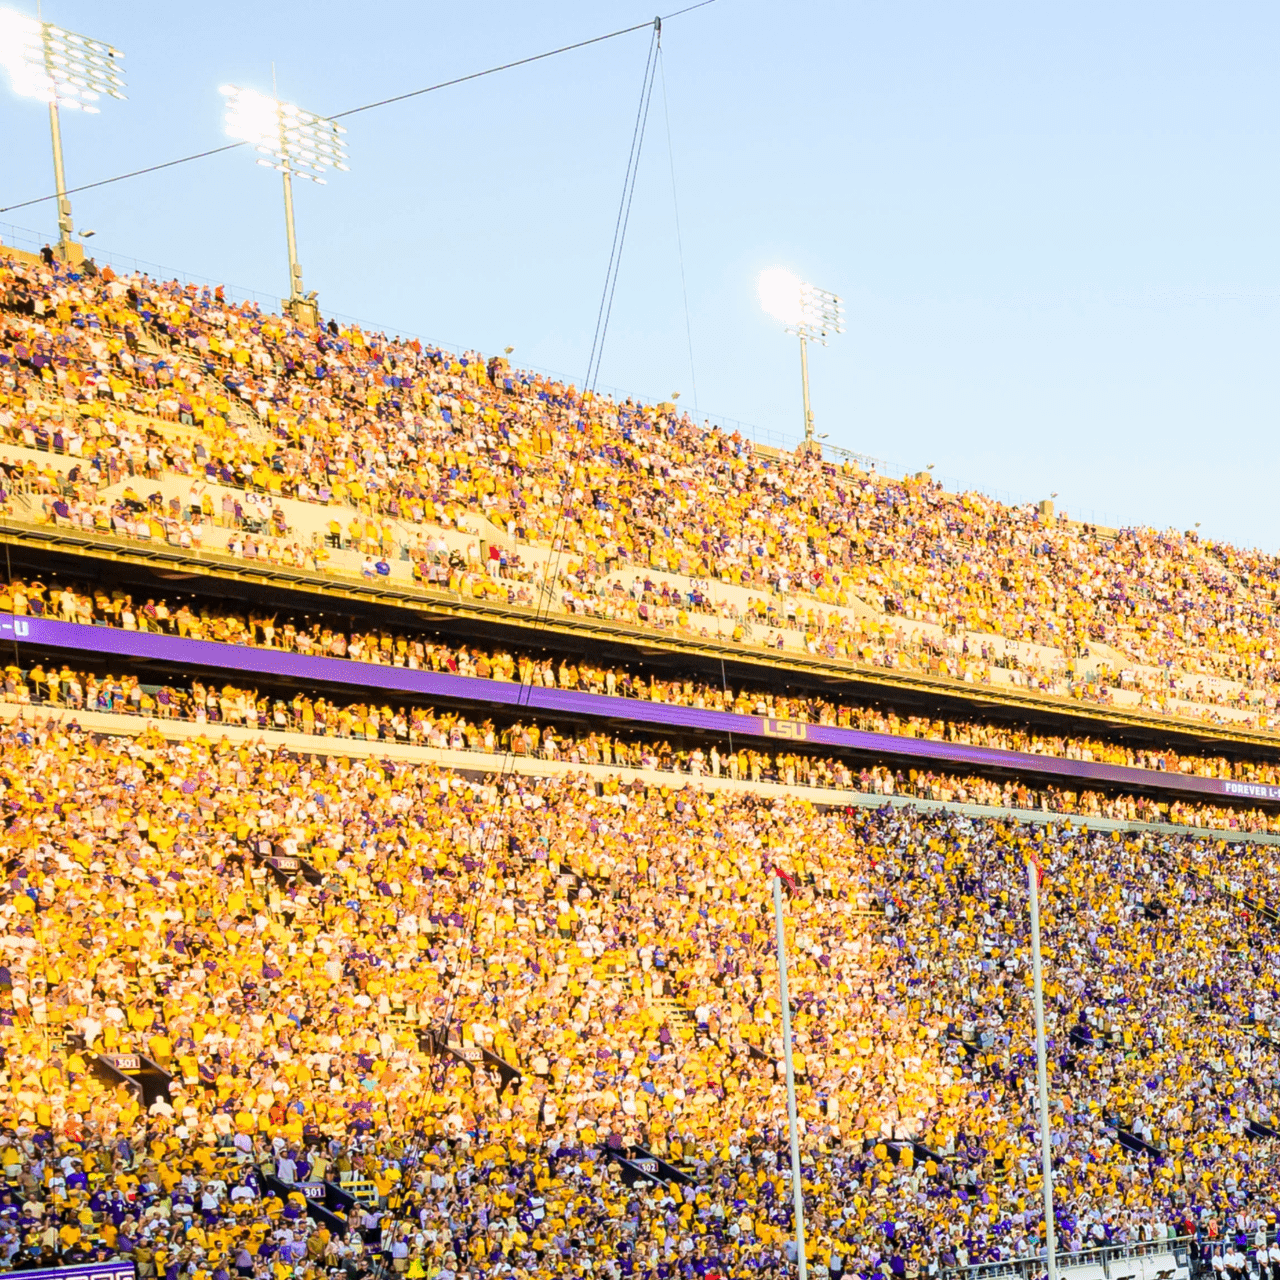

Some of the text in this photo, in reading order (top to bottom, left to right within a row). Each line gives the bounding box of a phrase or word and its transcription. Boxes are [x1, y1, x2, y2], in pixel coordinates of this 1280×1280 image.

[762, 719, 806, 741] LSU
[1225, 782, 1267, 797] FOREVER
[642, 1163, 656, 1172] 302
